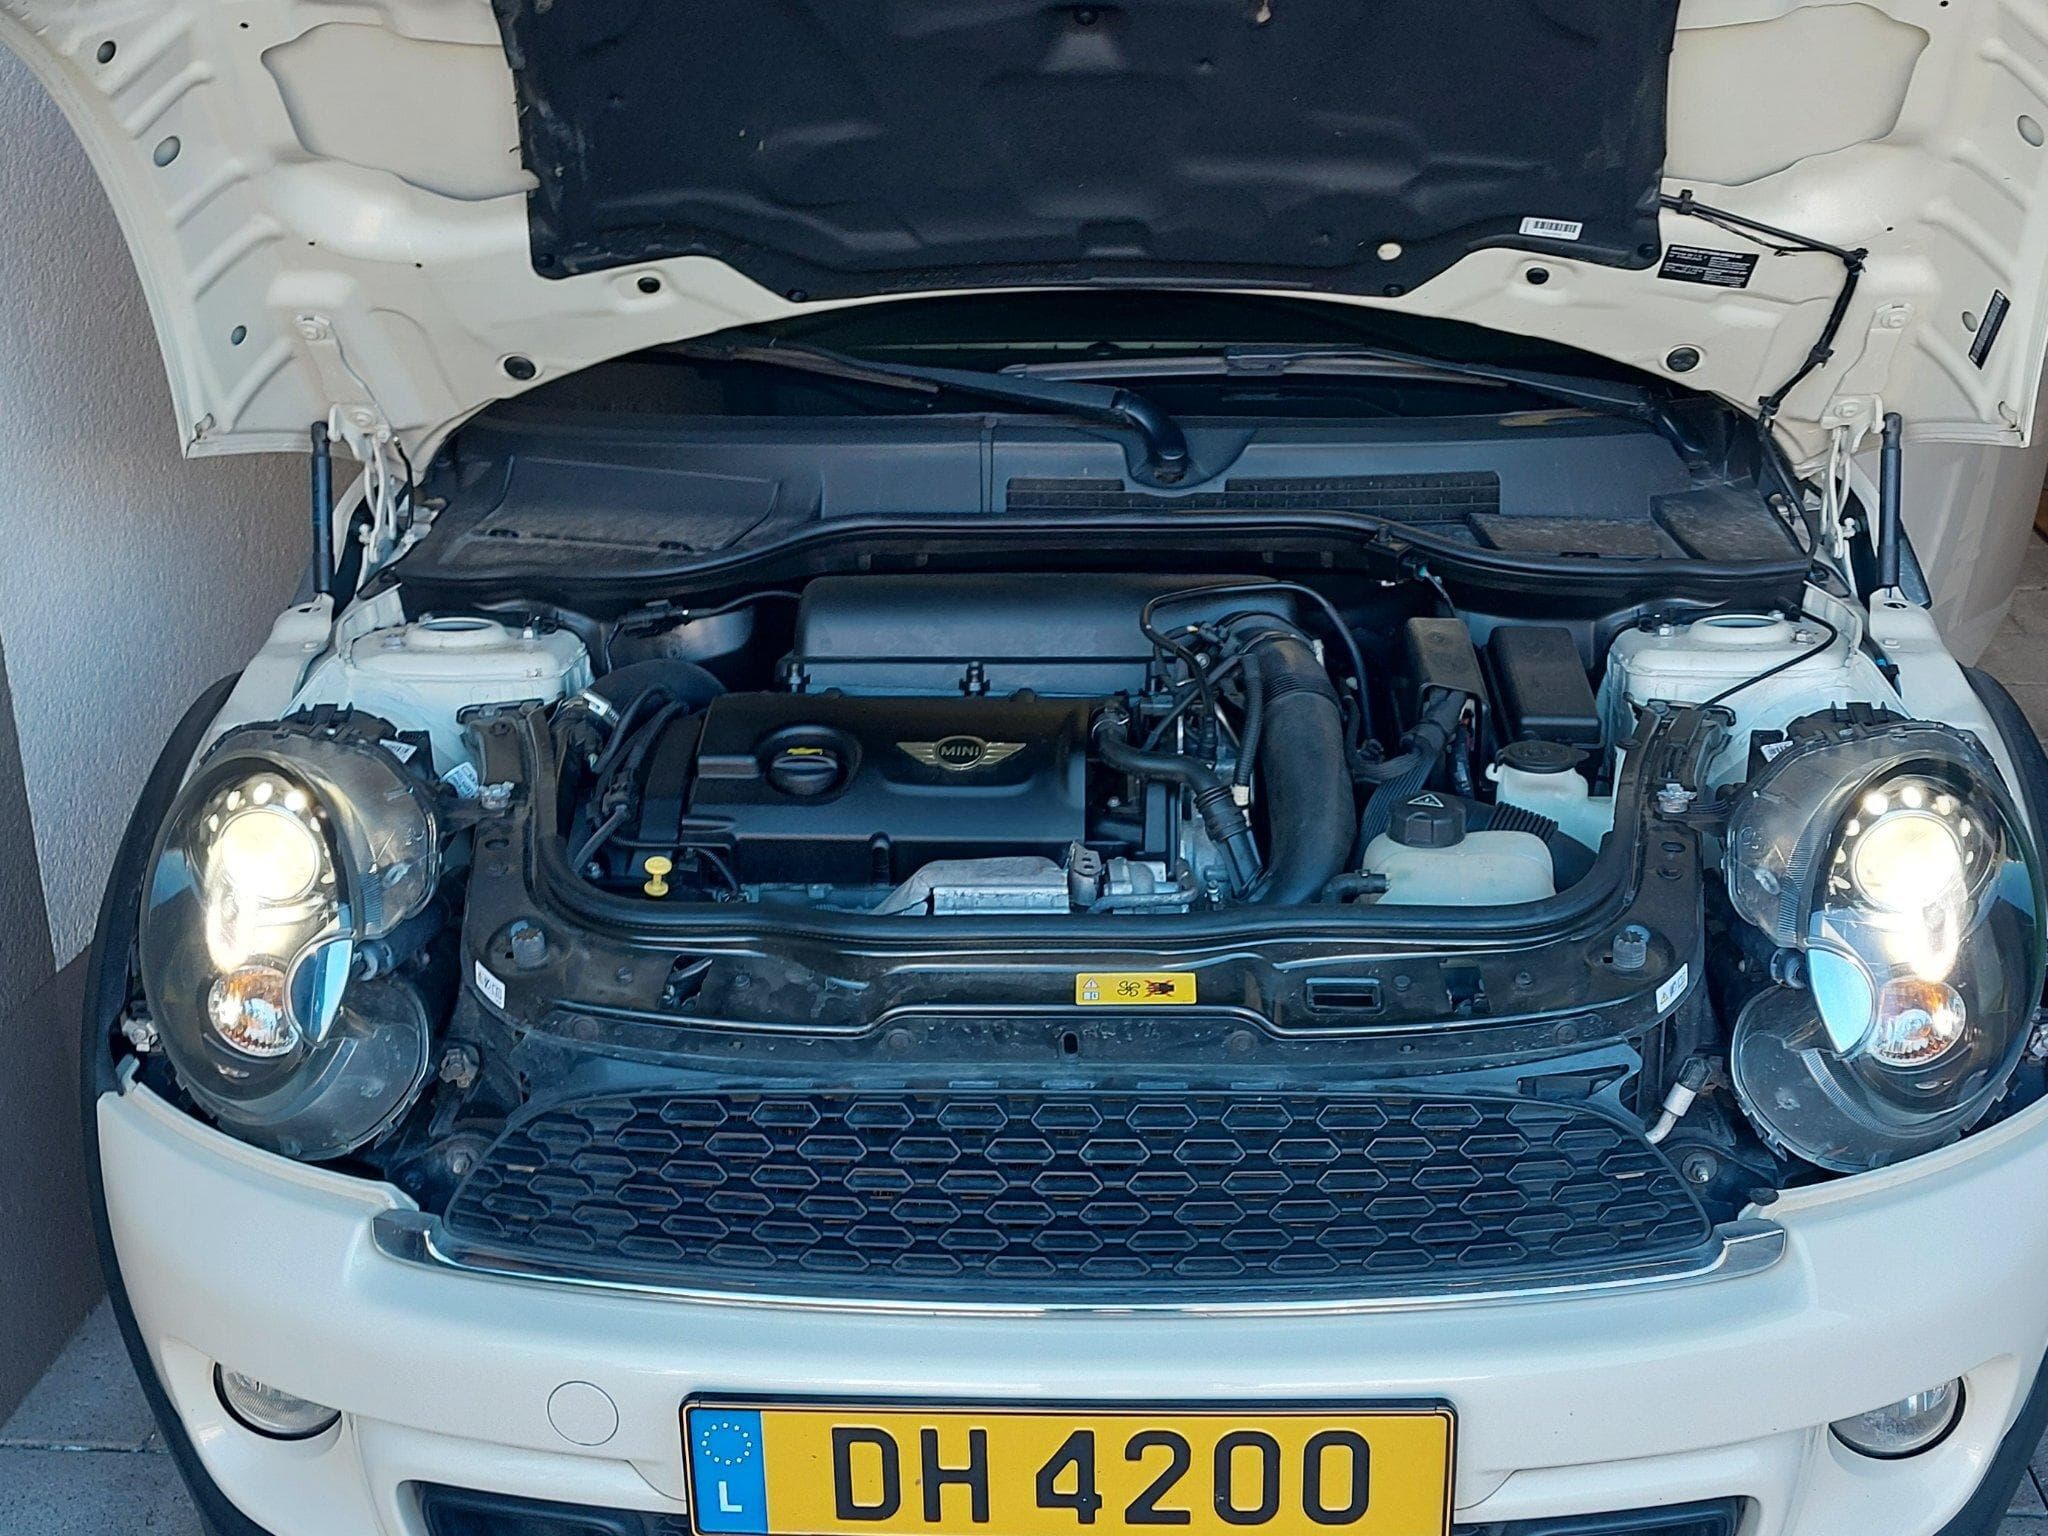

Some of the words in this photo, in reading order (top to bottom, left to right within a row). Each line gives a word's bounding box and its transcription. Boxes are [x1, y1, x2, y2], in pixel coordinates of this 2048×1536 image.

[940, 745, 980, 757] MINI
[831, 1427, 990, 1524] DH
[1035, 1429, 1371, 1526] 4200
[718, 1481, 743, 1514] L
